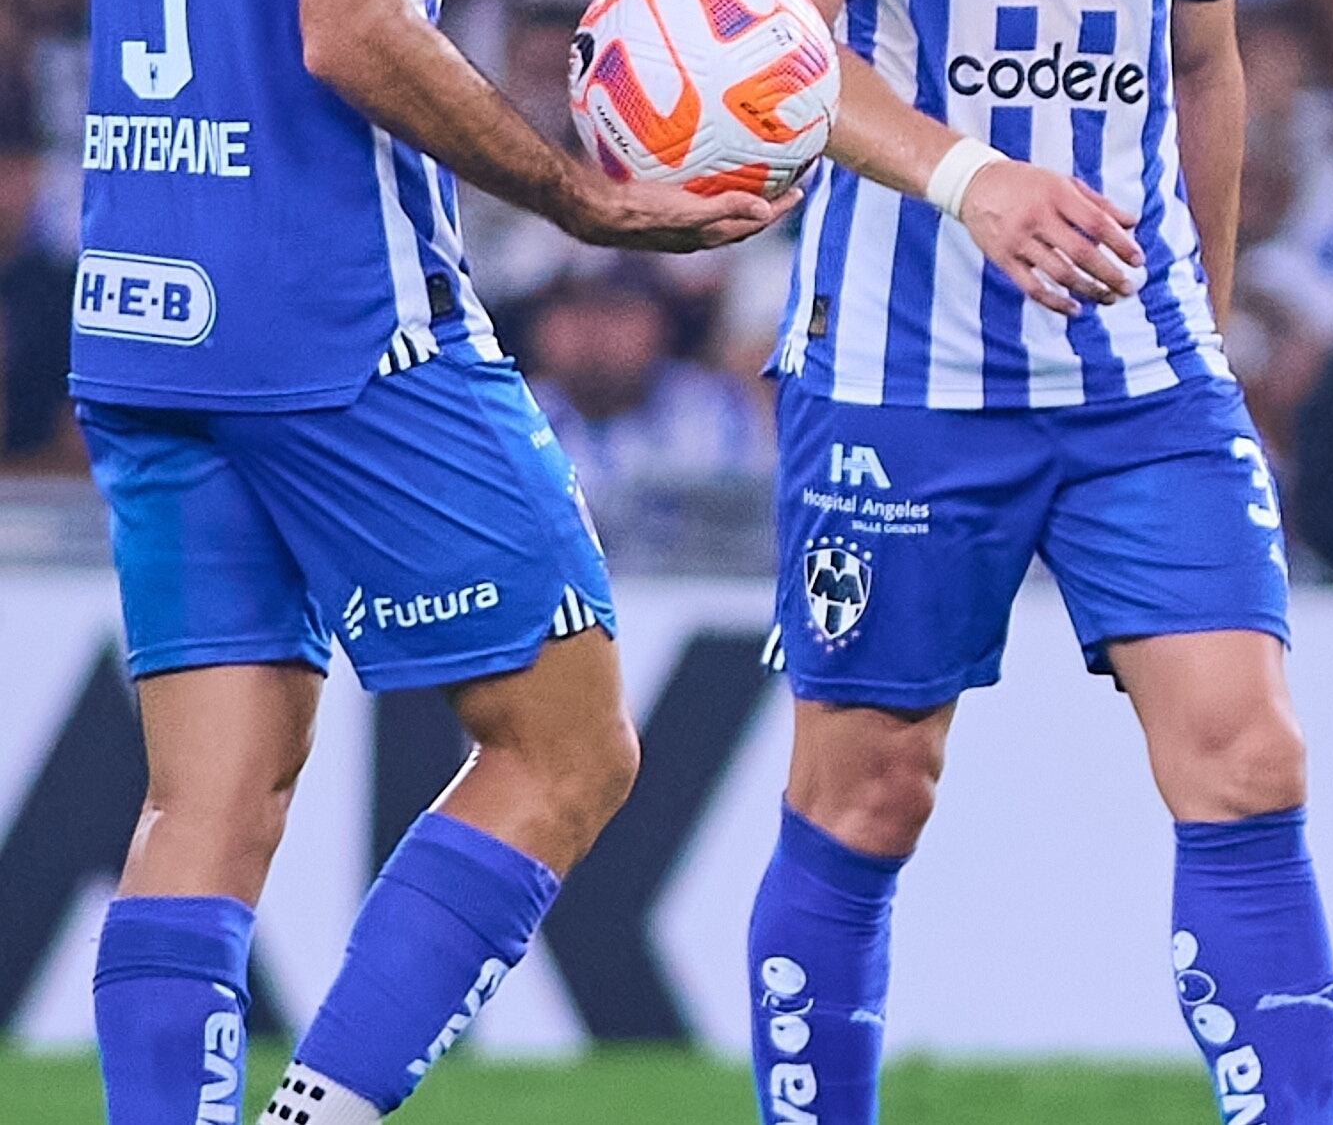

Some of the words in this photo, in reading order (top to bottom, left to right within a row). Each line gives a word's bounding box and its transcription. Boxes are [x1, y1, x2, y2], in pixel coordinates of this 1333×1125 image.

[948, 42, 1144, 104] codere
[861, 498, 930, 522] Angeles
[373, 582, 499, 629] Futura
